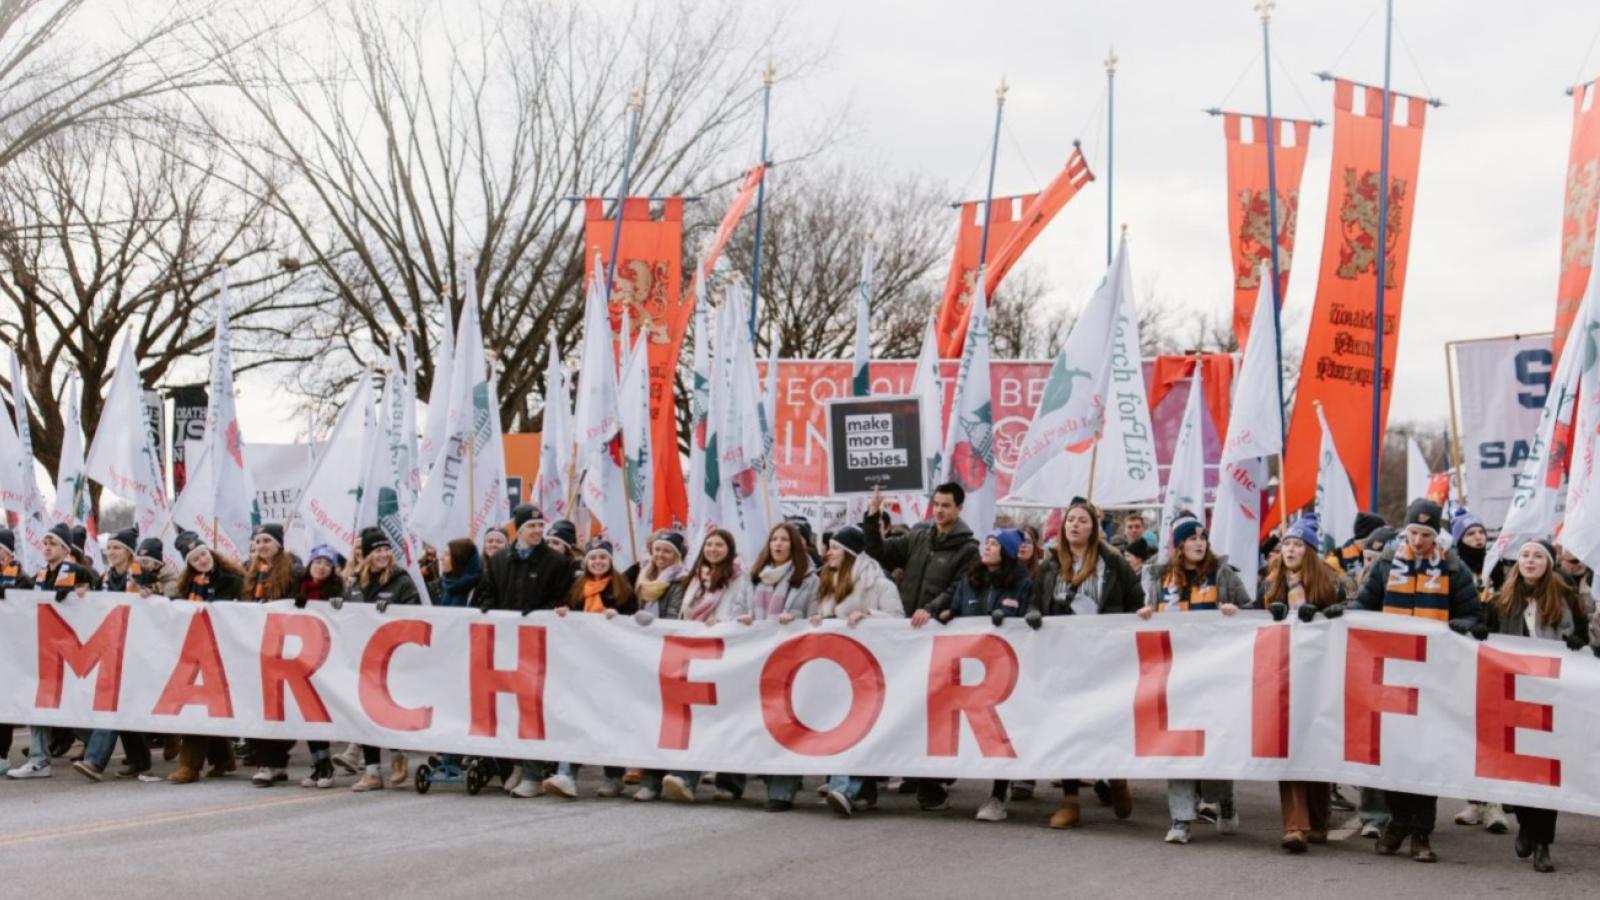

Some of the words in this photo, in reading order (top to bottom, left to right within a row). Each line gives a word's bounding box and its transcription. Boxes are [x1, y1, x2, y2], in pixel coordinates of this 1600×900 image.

[848, 415, 890, 431] make
[848, 435, 890, 447] more
[849, 452, 907, 467] babies.
[37, 602, 547, 740] MARCH
[658, 634, 1019, 757] FOR
[1134, 625, 1562, 787] LIFE
